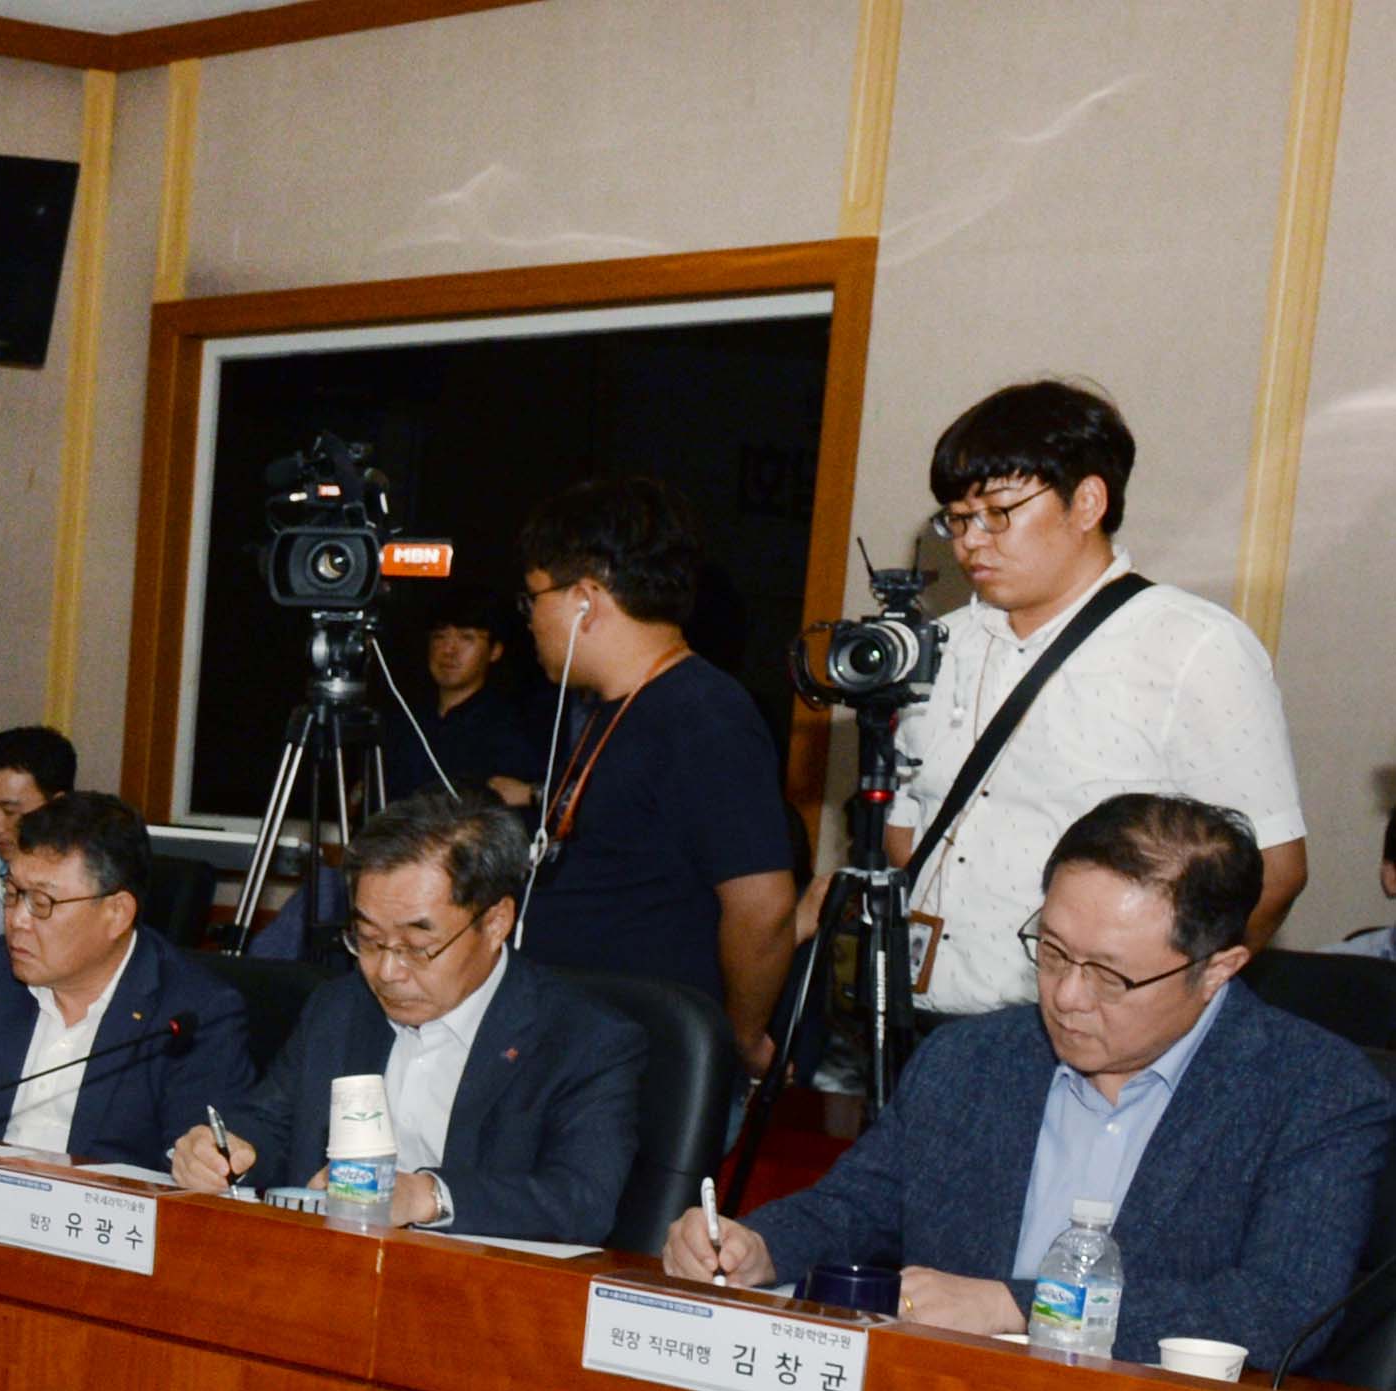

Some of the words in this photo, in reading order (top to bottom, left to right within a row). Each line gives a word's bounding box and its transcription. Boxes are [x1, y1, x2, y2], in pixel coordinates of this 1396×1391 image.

[393, 547, 440, 564] MBN
[29, 1212, 51, 1232] 원장
[610, 1326, 641, 1351] 원장
[648, 1334, 712, 1366] 직무대행
[770, 1321, 853, 1350] 한국화학연구원
